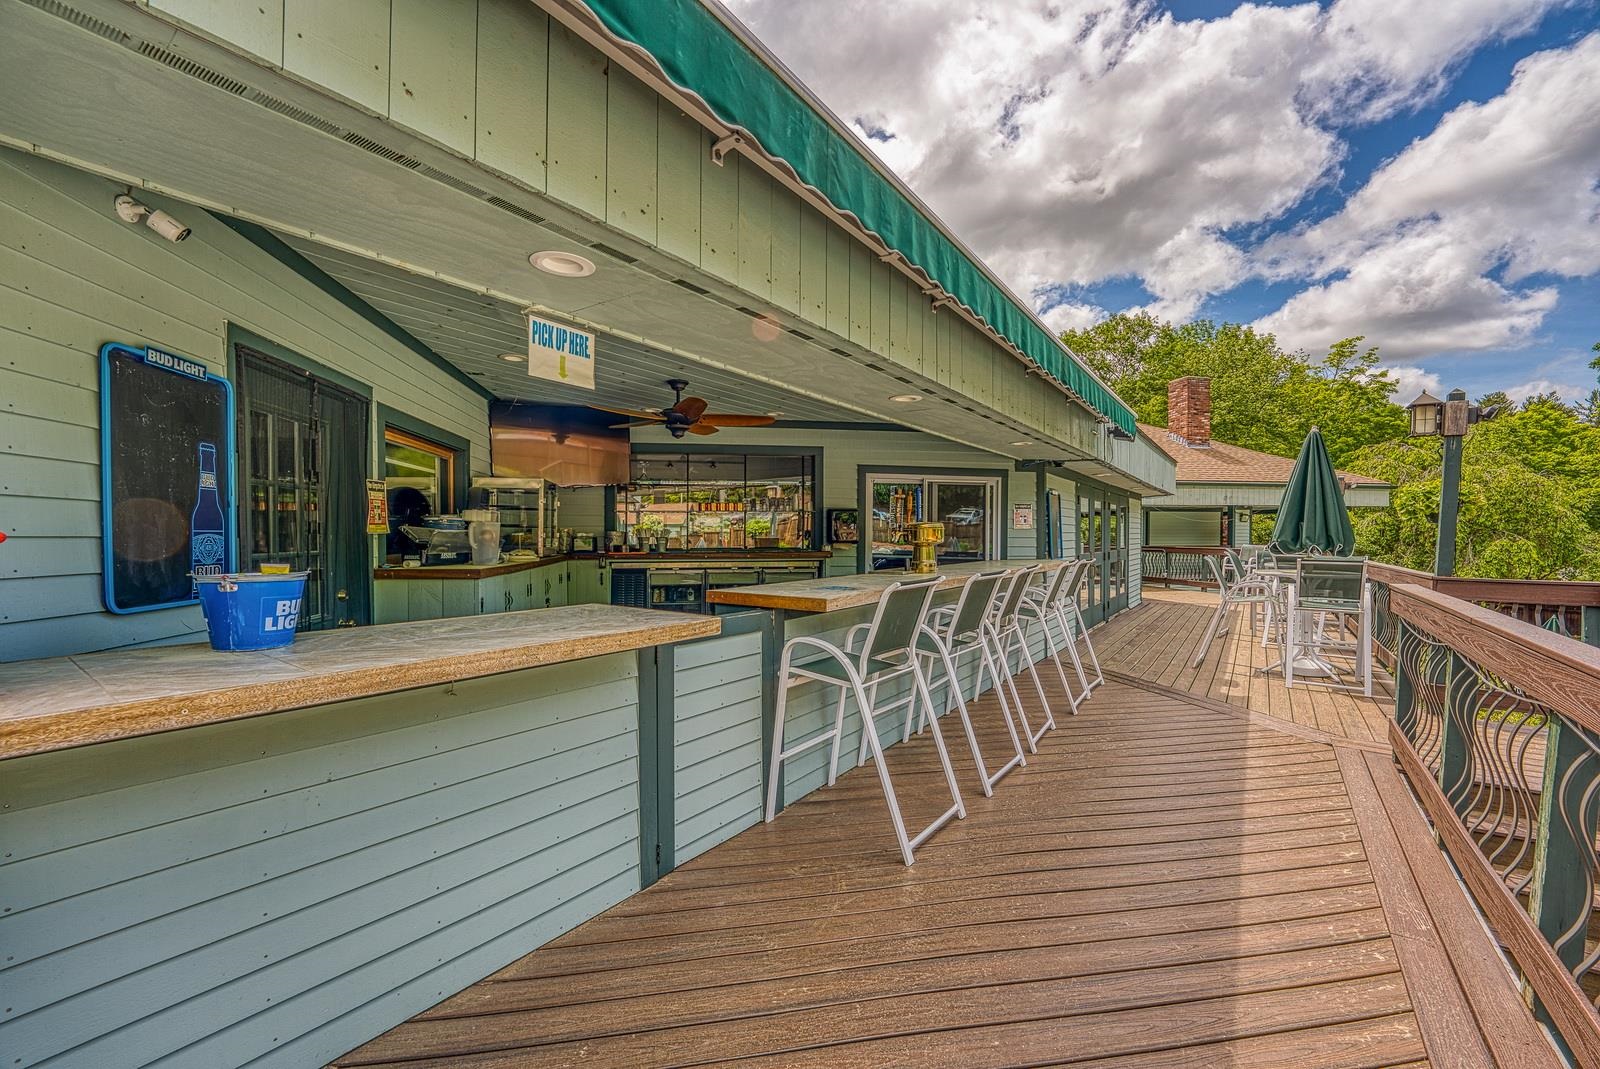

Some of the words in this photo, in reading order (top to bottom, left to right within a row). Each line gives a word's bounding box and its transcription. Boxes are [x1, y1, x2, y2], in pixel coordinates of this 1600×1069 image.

[532, 319, 554, 349] PICK
[556, 327, 568, 352] UP
[147, 349, 174, 367] BUD
[173, 358, 206, 378] LIGHT
[275, 598, 302, 617] BU
[264, 613, 298, 632] LIG
